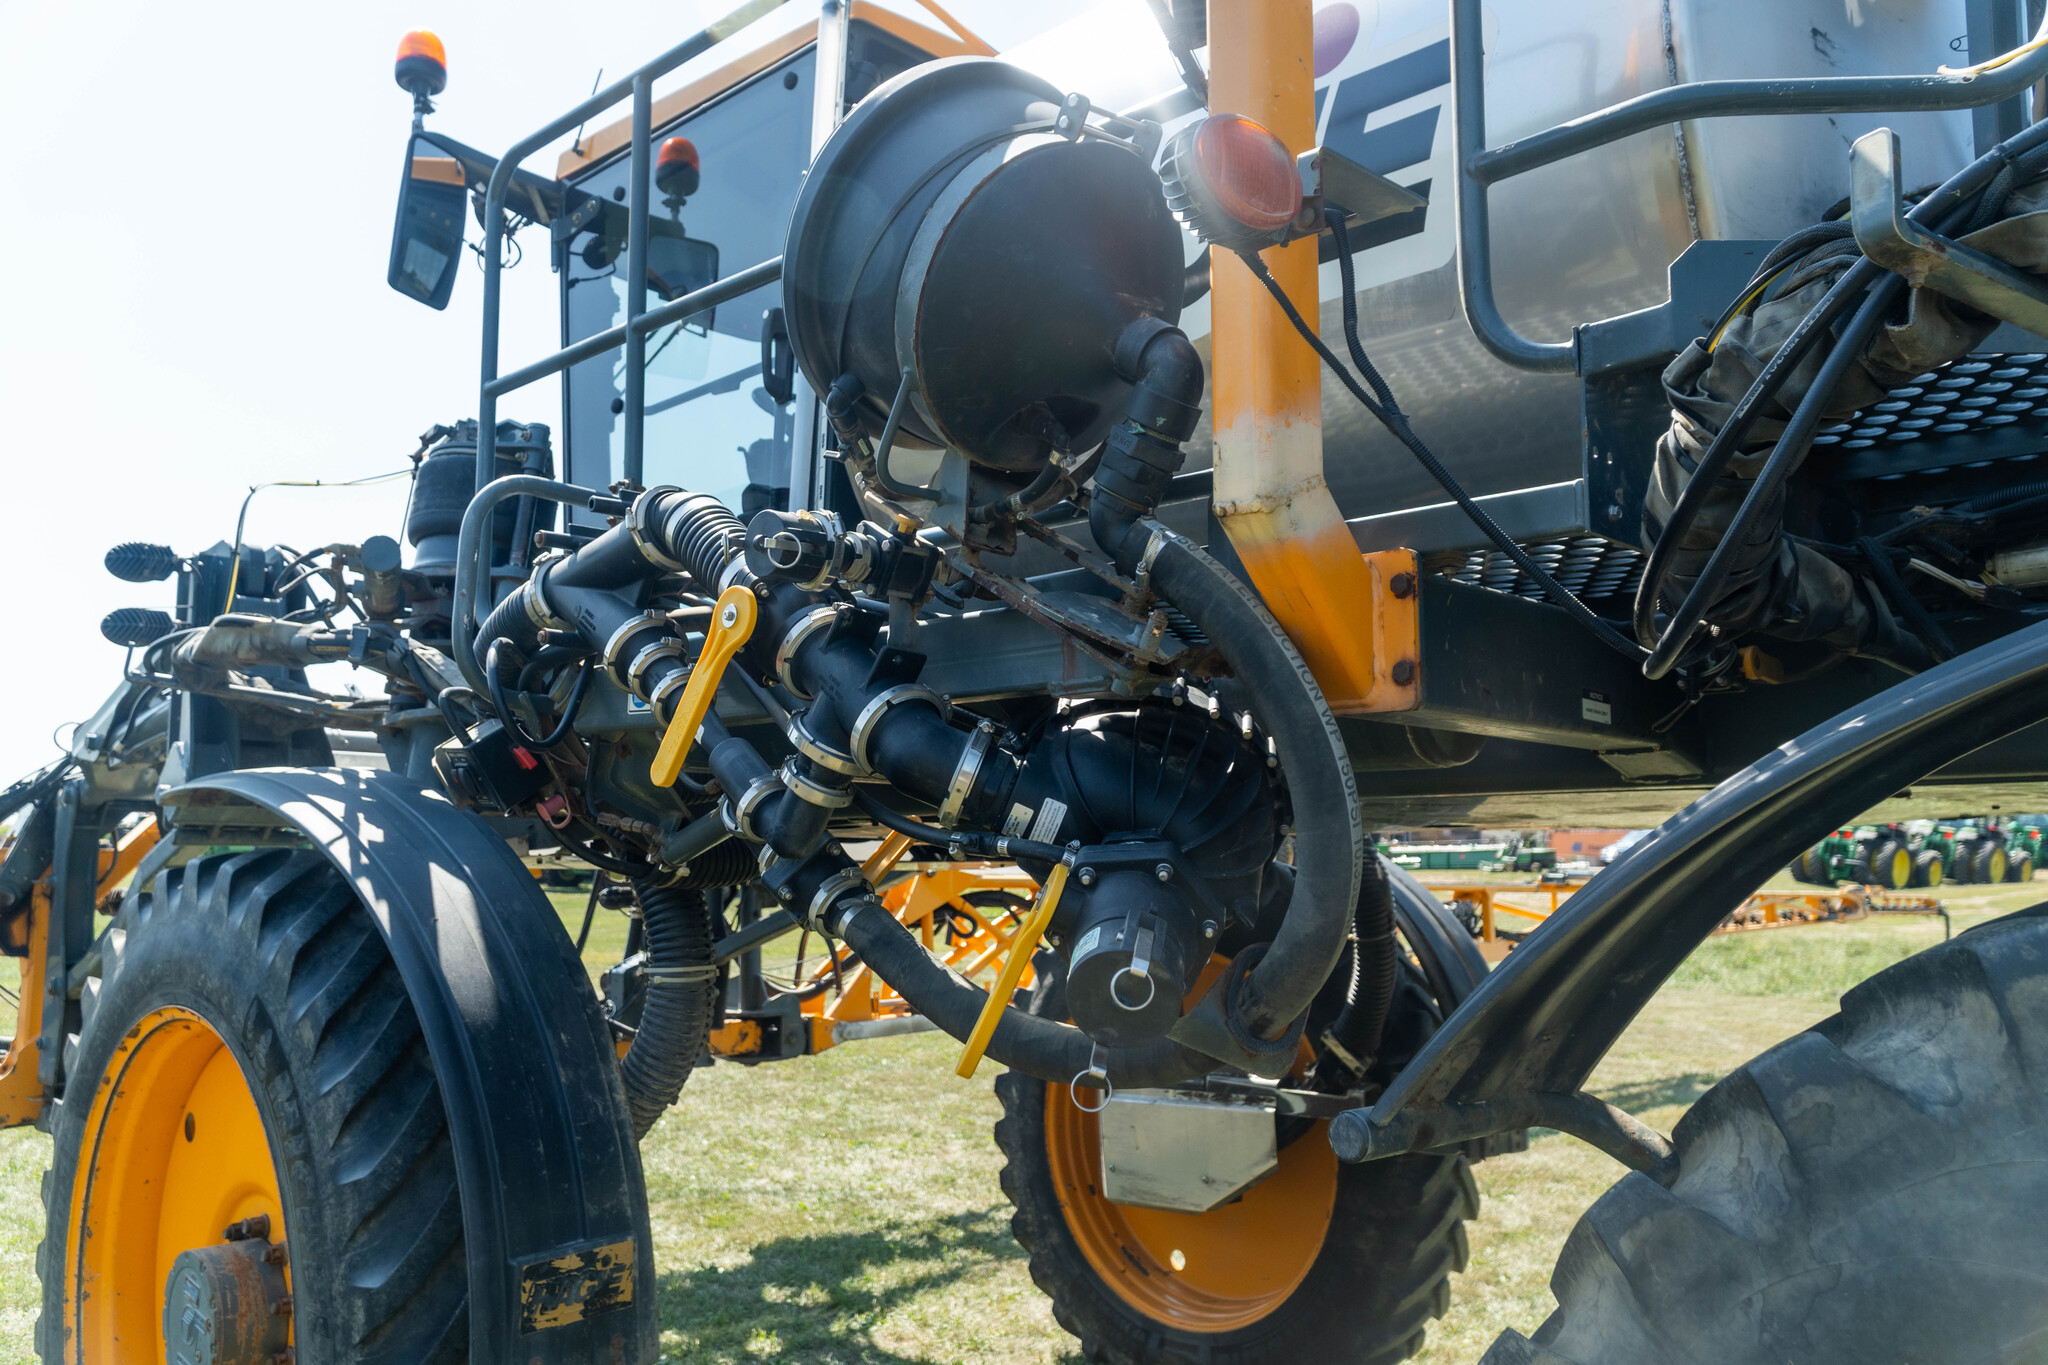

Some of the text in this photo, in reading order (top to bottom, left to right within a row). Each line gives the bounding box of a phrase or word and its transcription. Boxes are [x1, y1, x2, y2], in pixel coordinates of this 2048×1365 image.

[1200, 552, 1262, 609] WATER
[1261, 609, 1324, 702] SUCTION
[1320, 708, 1342, 742] WP
[1338, 750, 1361, 828] 150PSI
[1589, 691, 1604, 702] NOTICE
